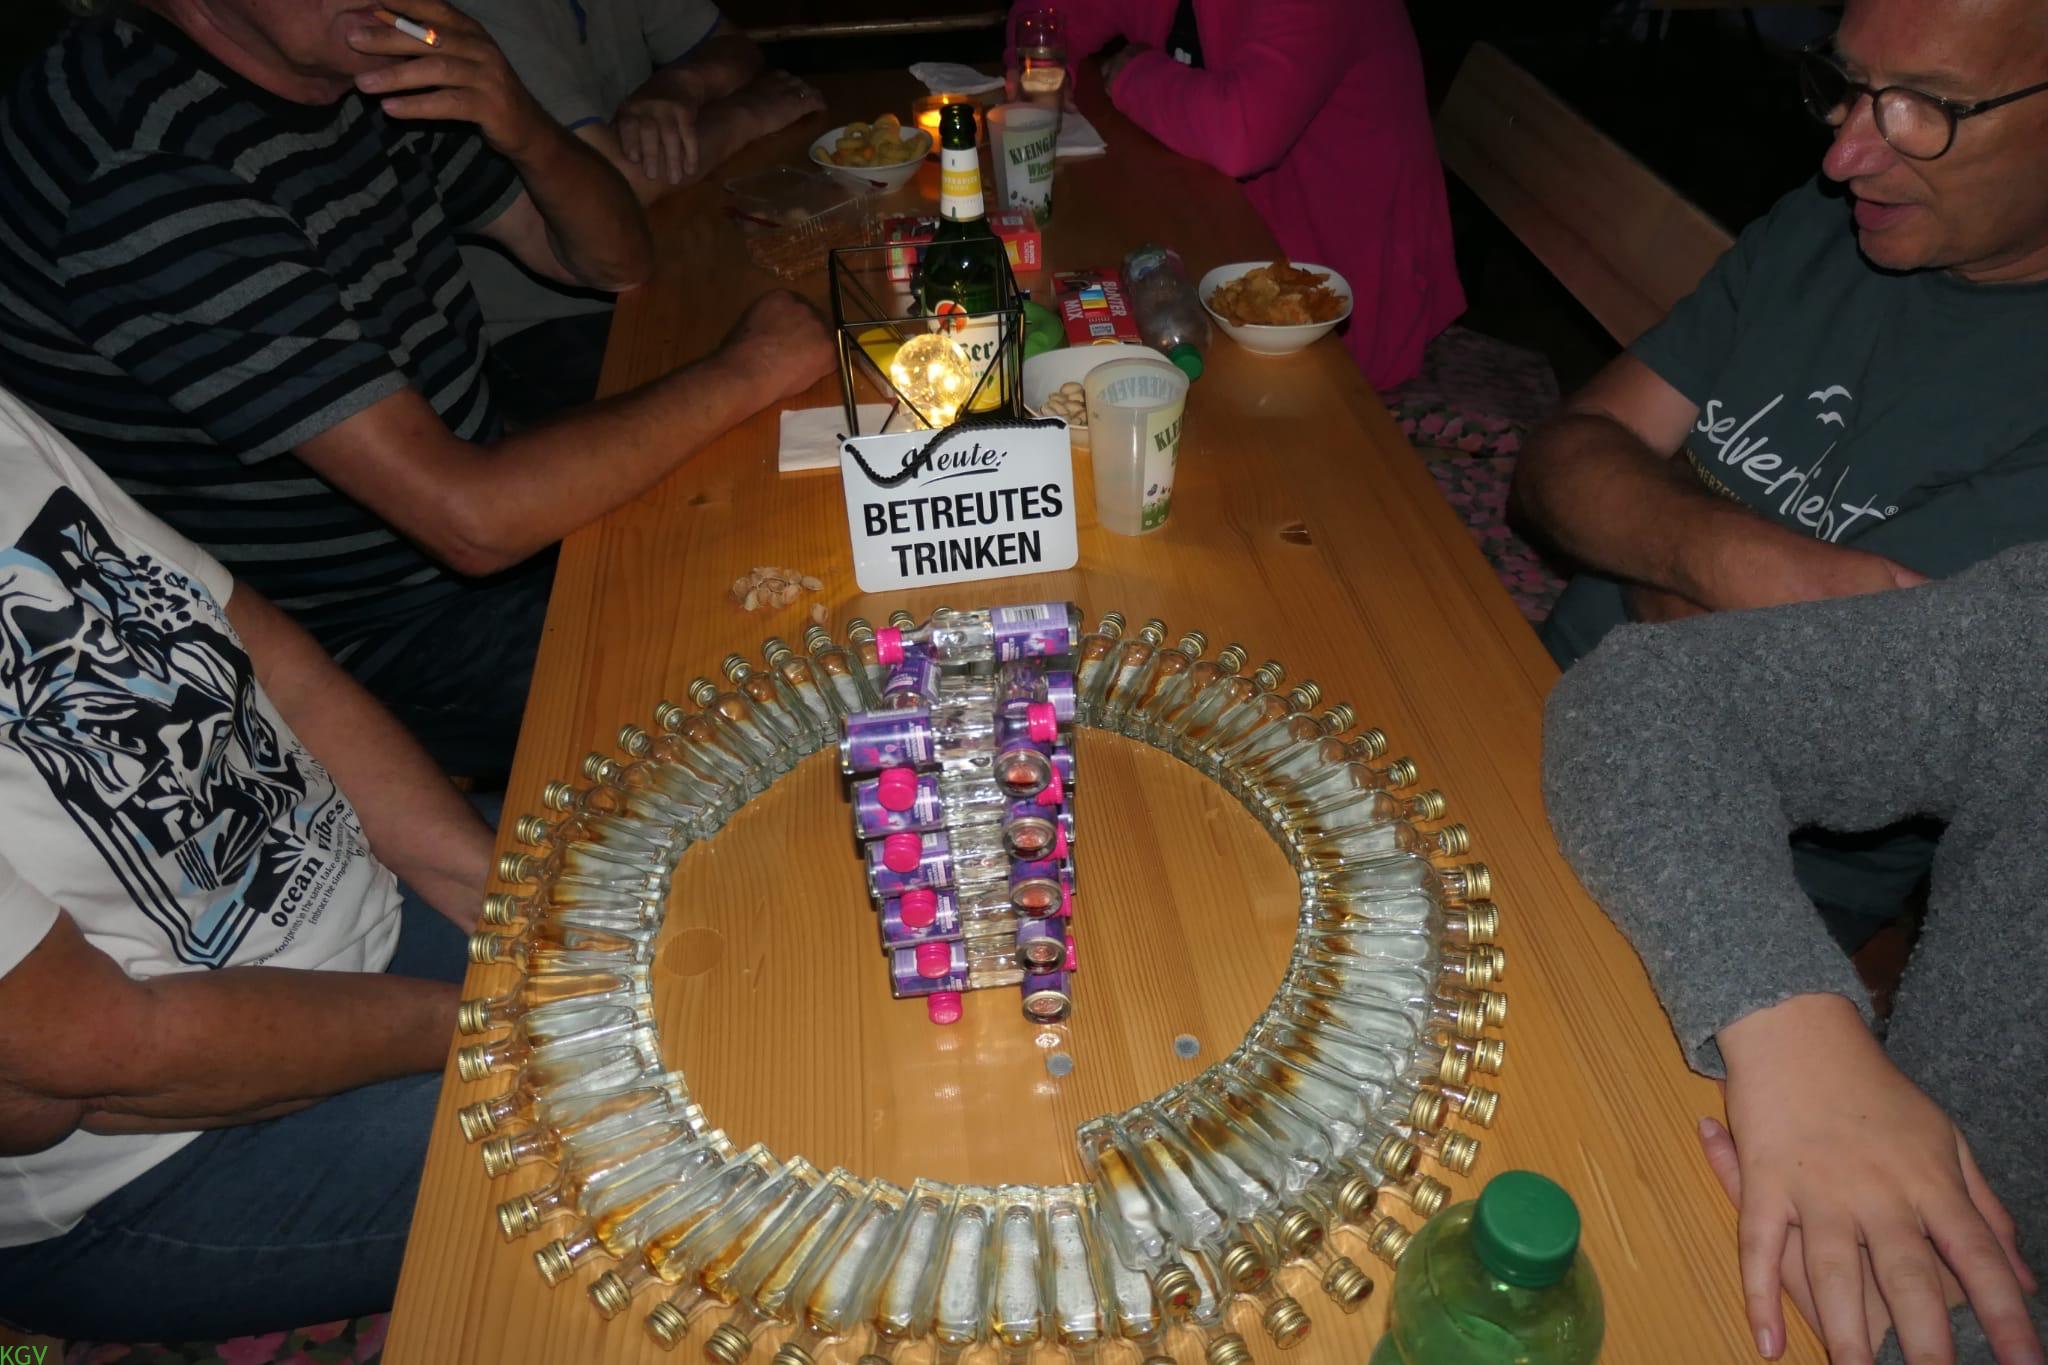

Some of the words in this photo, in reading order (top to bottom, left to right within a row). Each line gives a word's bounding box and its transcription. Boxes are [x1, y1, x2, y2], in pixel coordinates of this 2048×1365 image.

[1063, 299, 1084, 321] MIX
[1102, 281, 1128, 317] BUNTER
[863, 483, 1063, 537] BETREUTES
[891, 530, 1042, 577] TRINKEN
[271, 857, 325, 928] ocean
[314, 799, 345, 851] vibes
[302, 898, 315, 913] the
[321, 862, 337, 881] take
[308, 897, 329, 925] Embrace
[323, 885, 336, 899] the
